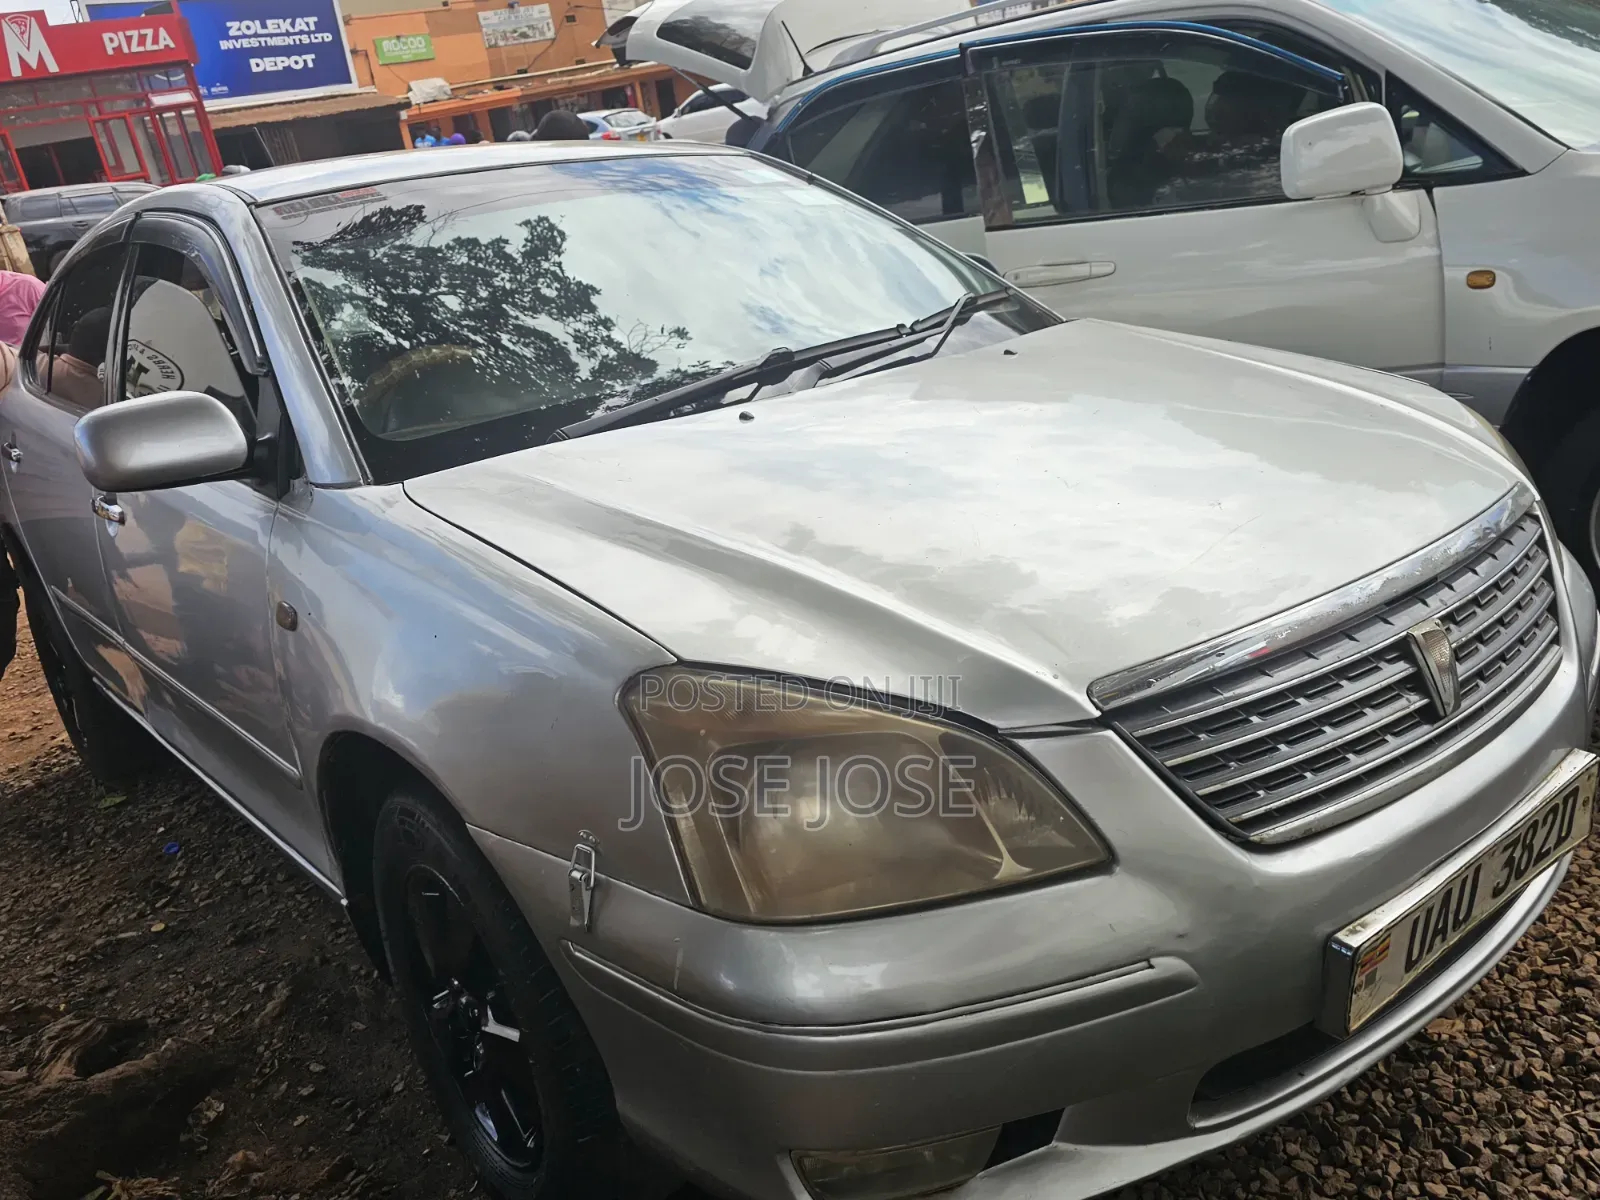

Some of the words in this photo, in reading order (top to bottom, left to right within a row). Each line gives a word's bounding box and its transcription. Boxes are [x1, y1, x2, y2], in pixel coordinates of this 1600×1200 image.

[226, 16, 319, 36] ZOLEKAT
[102, 27, 175, 56] PIZZA
[219, 35, 309, 50] INVESTMENTS
[309, 32, 333, 44] LTD
[249, 53, 316, 73] DEPOT
[1405, 863, 1483, 974] UAU
[1492, 785, 1579, 899] 382D
